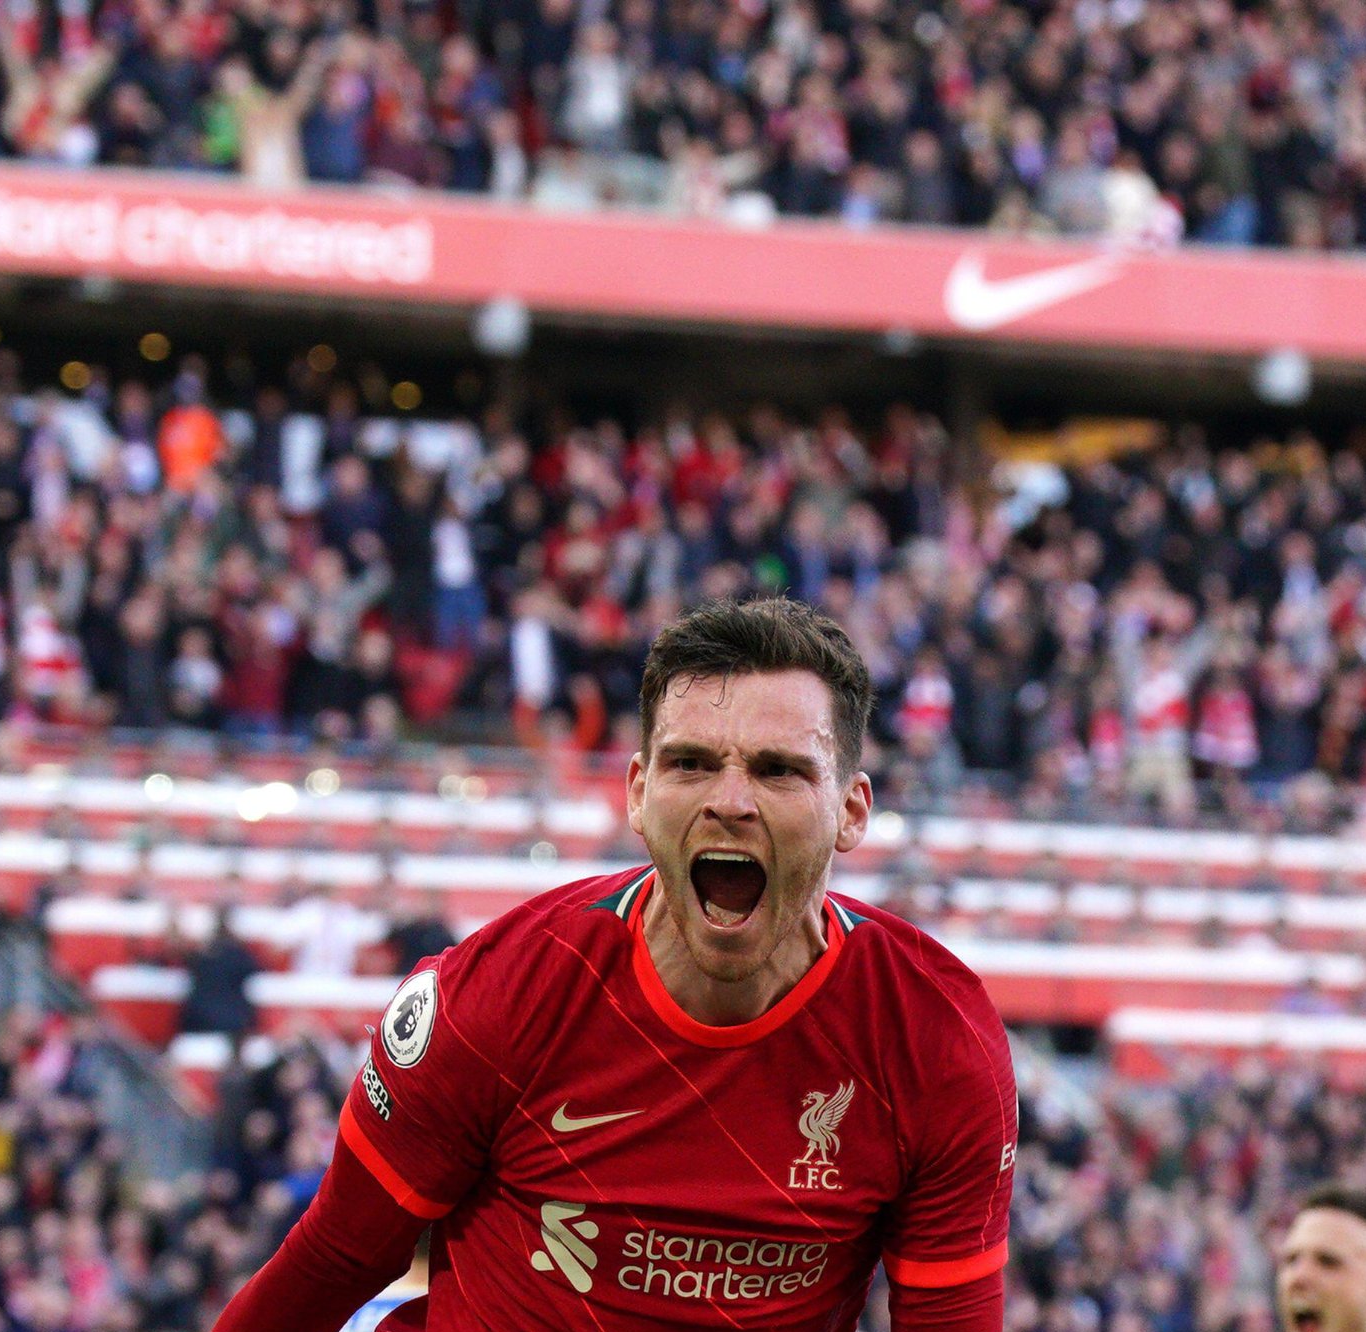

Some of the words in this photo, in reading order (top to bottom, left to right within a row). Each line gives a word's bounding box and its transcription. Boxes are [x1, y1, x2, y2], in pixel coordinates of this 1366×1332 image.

[123, 202, 432, 284] chartered
[788, 1166, 843, 1190] L.F.C.
[622, 1229, 828, 1267] standard
[617, 1257, 829, 1300] chartered
